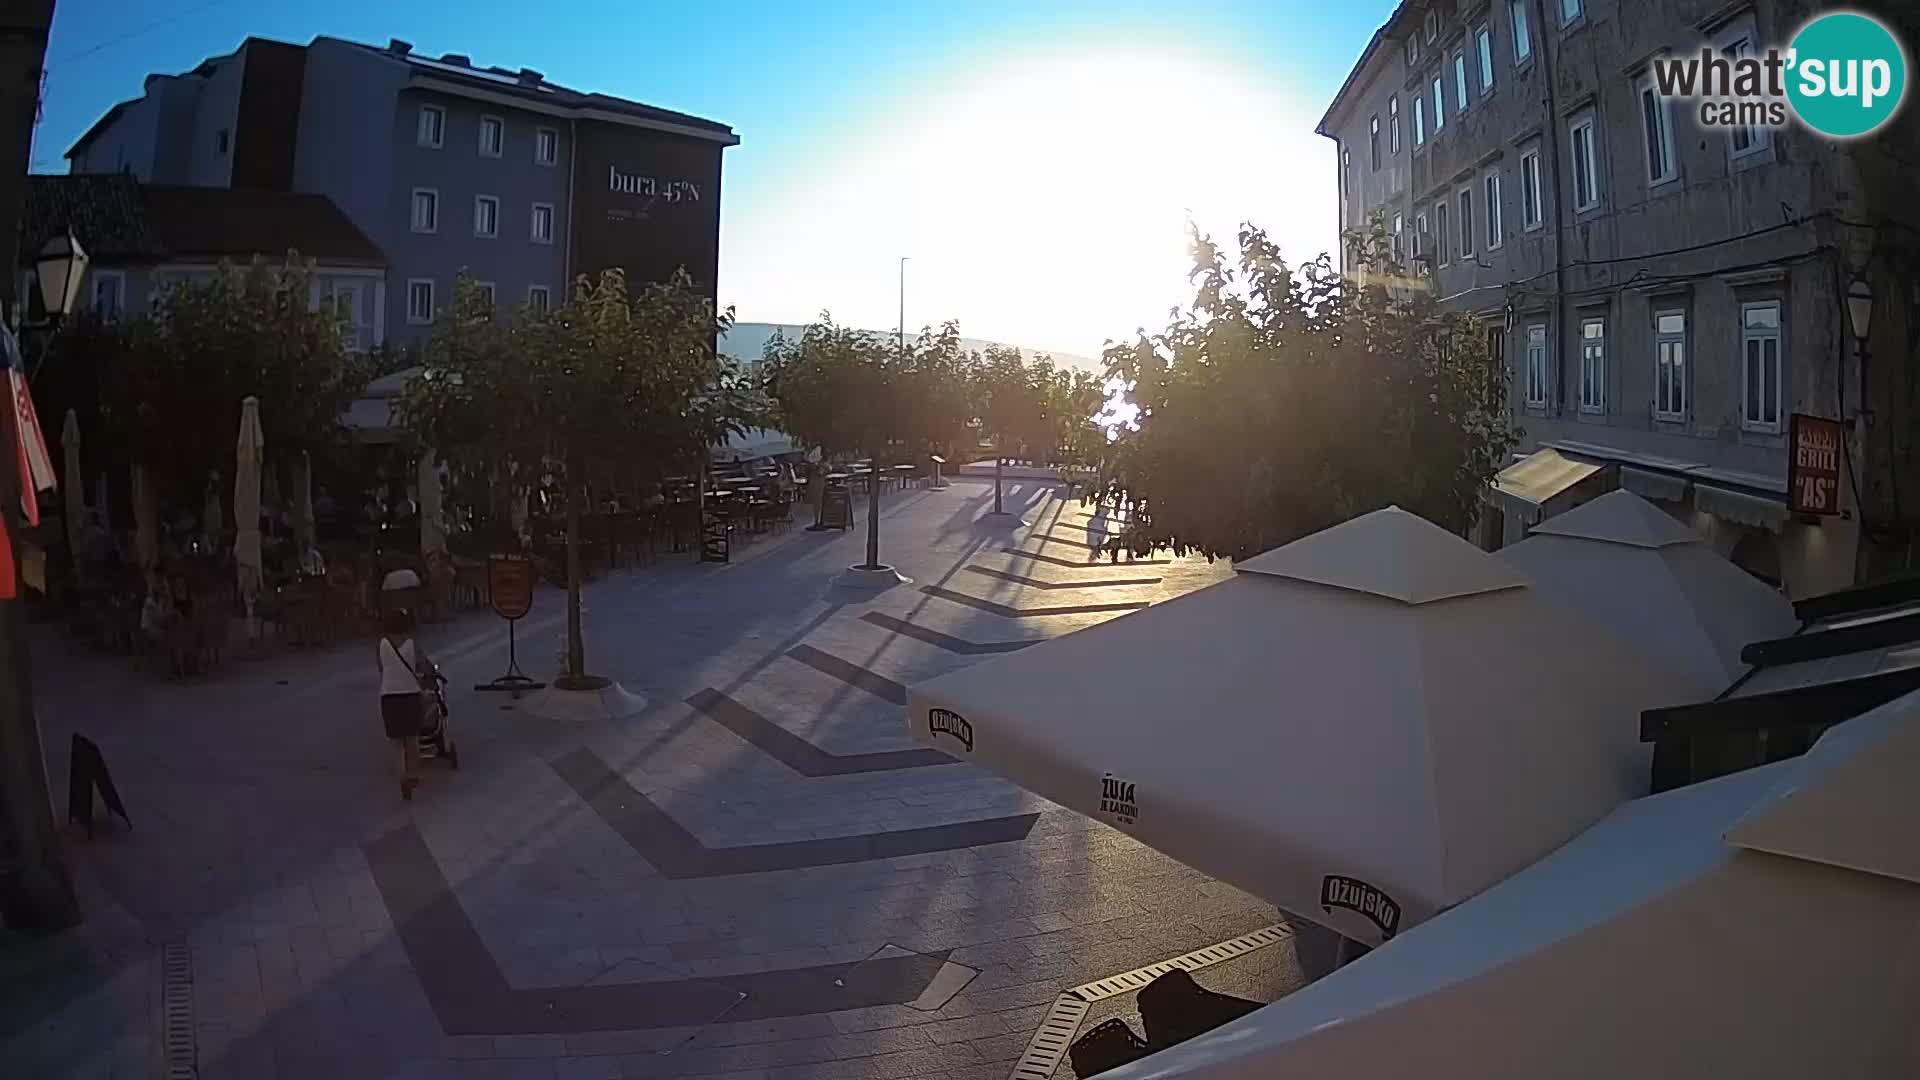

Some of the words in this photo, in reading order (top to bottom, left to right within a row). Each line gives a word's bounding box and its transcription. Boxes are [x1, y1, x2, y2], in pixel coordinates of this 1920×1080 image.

[610, 165, 656, 195] bura
[1797, 447, 1836, 471] GRILL
[932, 710, 970, 742] Ožujsko
[1101, 772, 1136, 805] ŽUJA
[1327, 878, 1394, 929] Ožujsko
